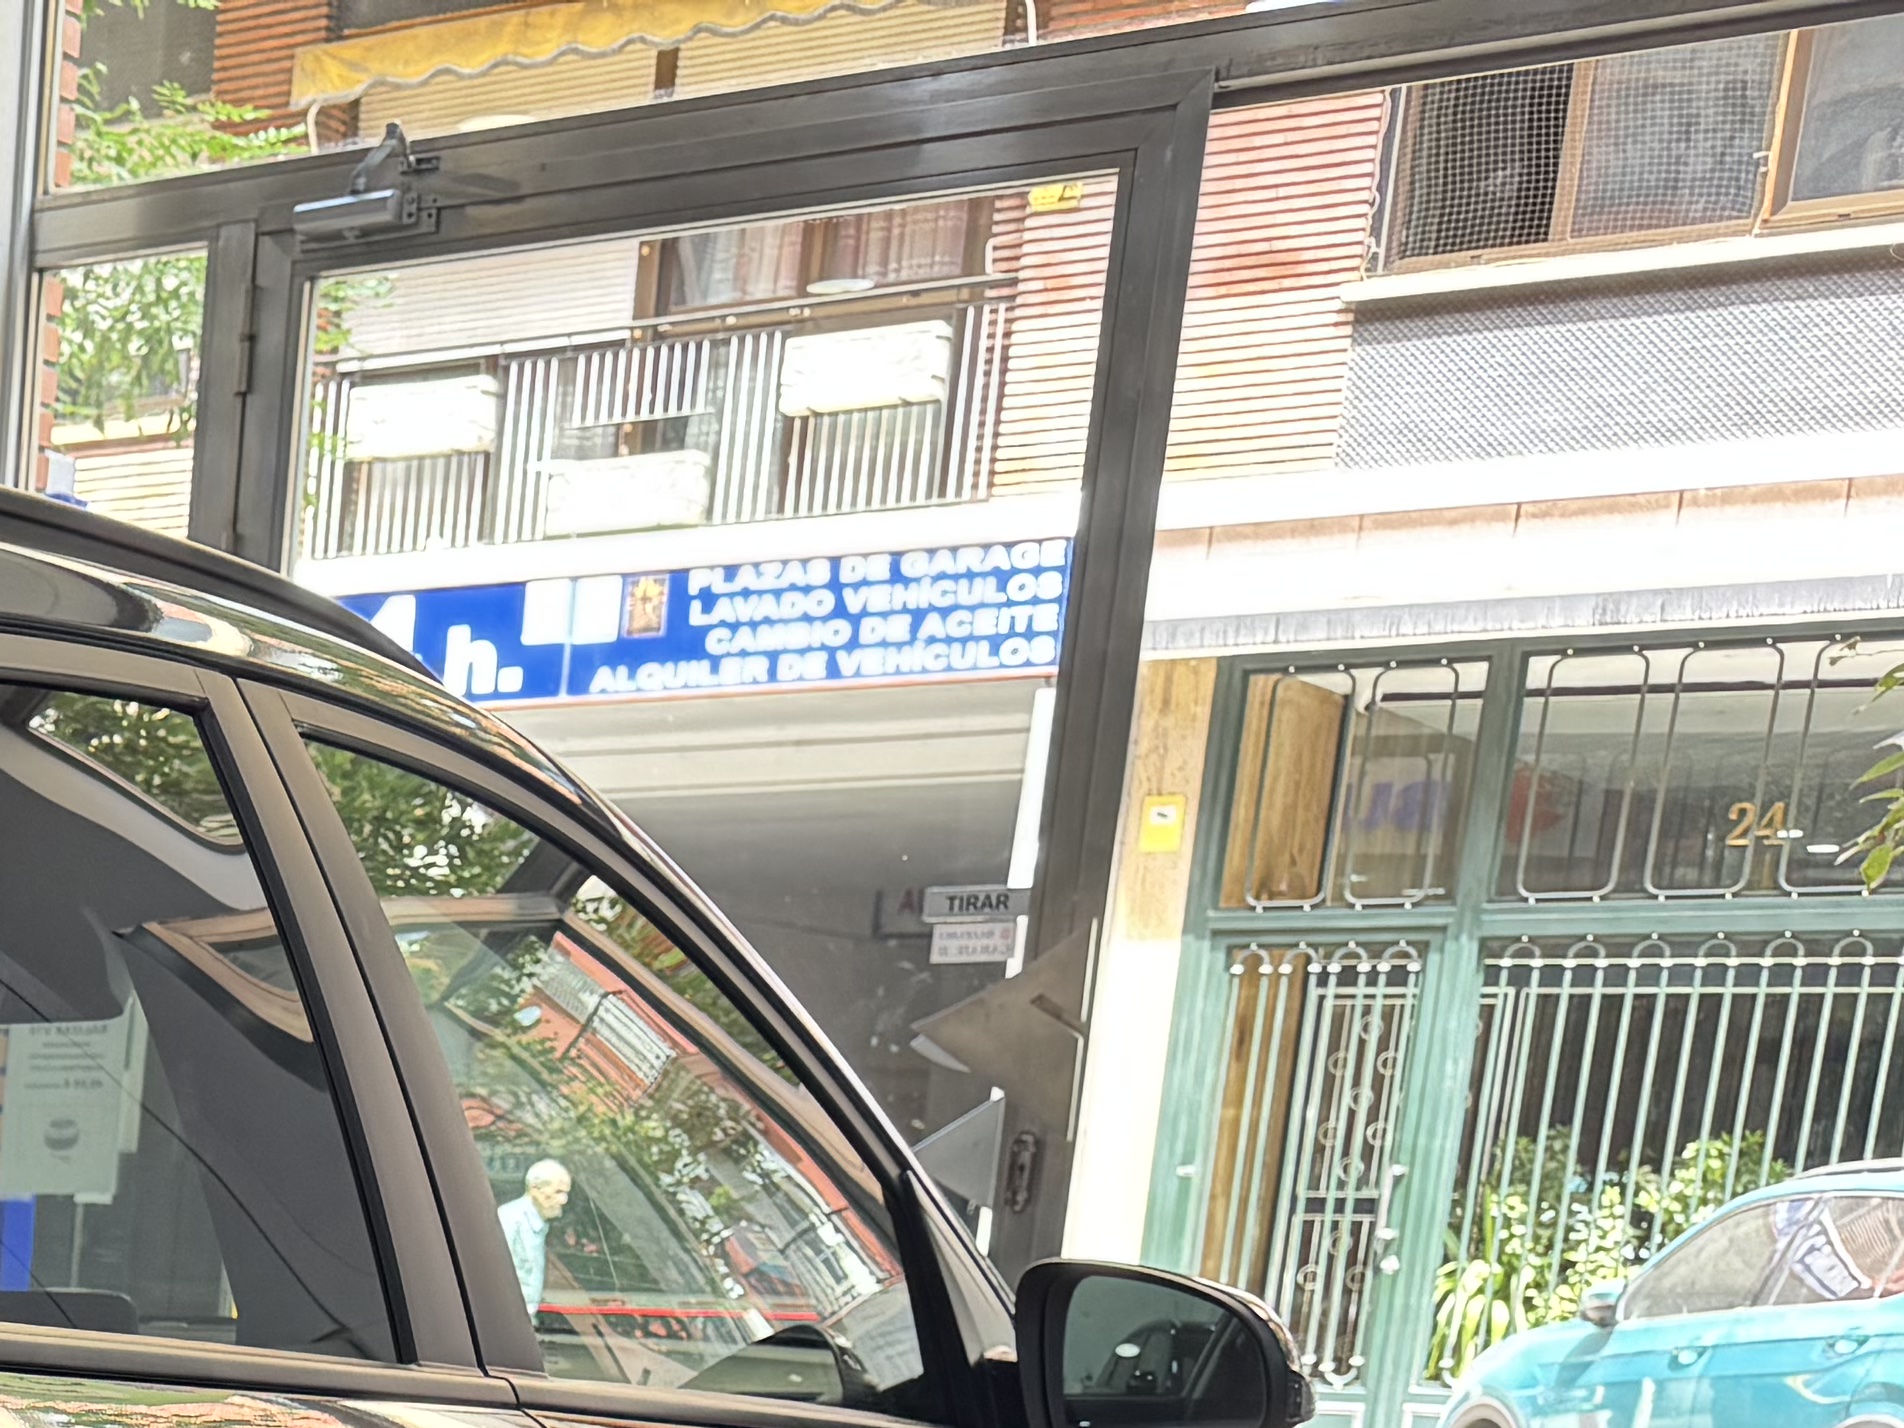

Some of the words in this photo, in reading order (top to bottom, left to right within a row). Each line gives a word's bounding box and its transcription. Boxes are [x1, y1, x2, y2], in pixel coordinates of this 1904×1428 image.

[688, 557, 831, 596] PLAZAS
[839, 553, 891, 585] DE
[899, 539, 1067, 578] GARAGE
[688, 588, 836, 626] LAVADO
[842, 570, 1064, 615] VEHÍCULOS
[705, 618, 852, 656] CAMBIO
[858, 613, 912, 646] DE
[916, 603, 1059, 640] ACEITE
[589, 655, 770, 693] ALQUILER
[776, 650, 828, 682] DE
[835, 635, 1056, 677] VEHÍCULOS
[1725, 801, 1789, 847] 24
[946, 892, 1010, 913] TIRAR
